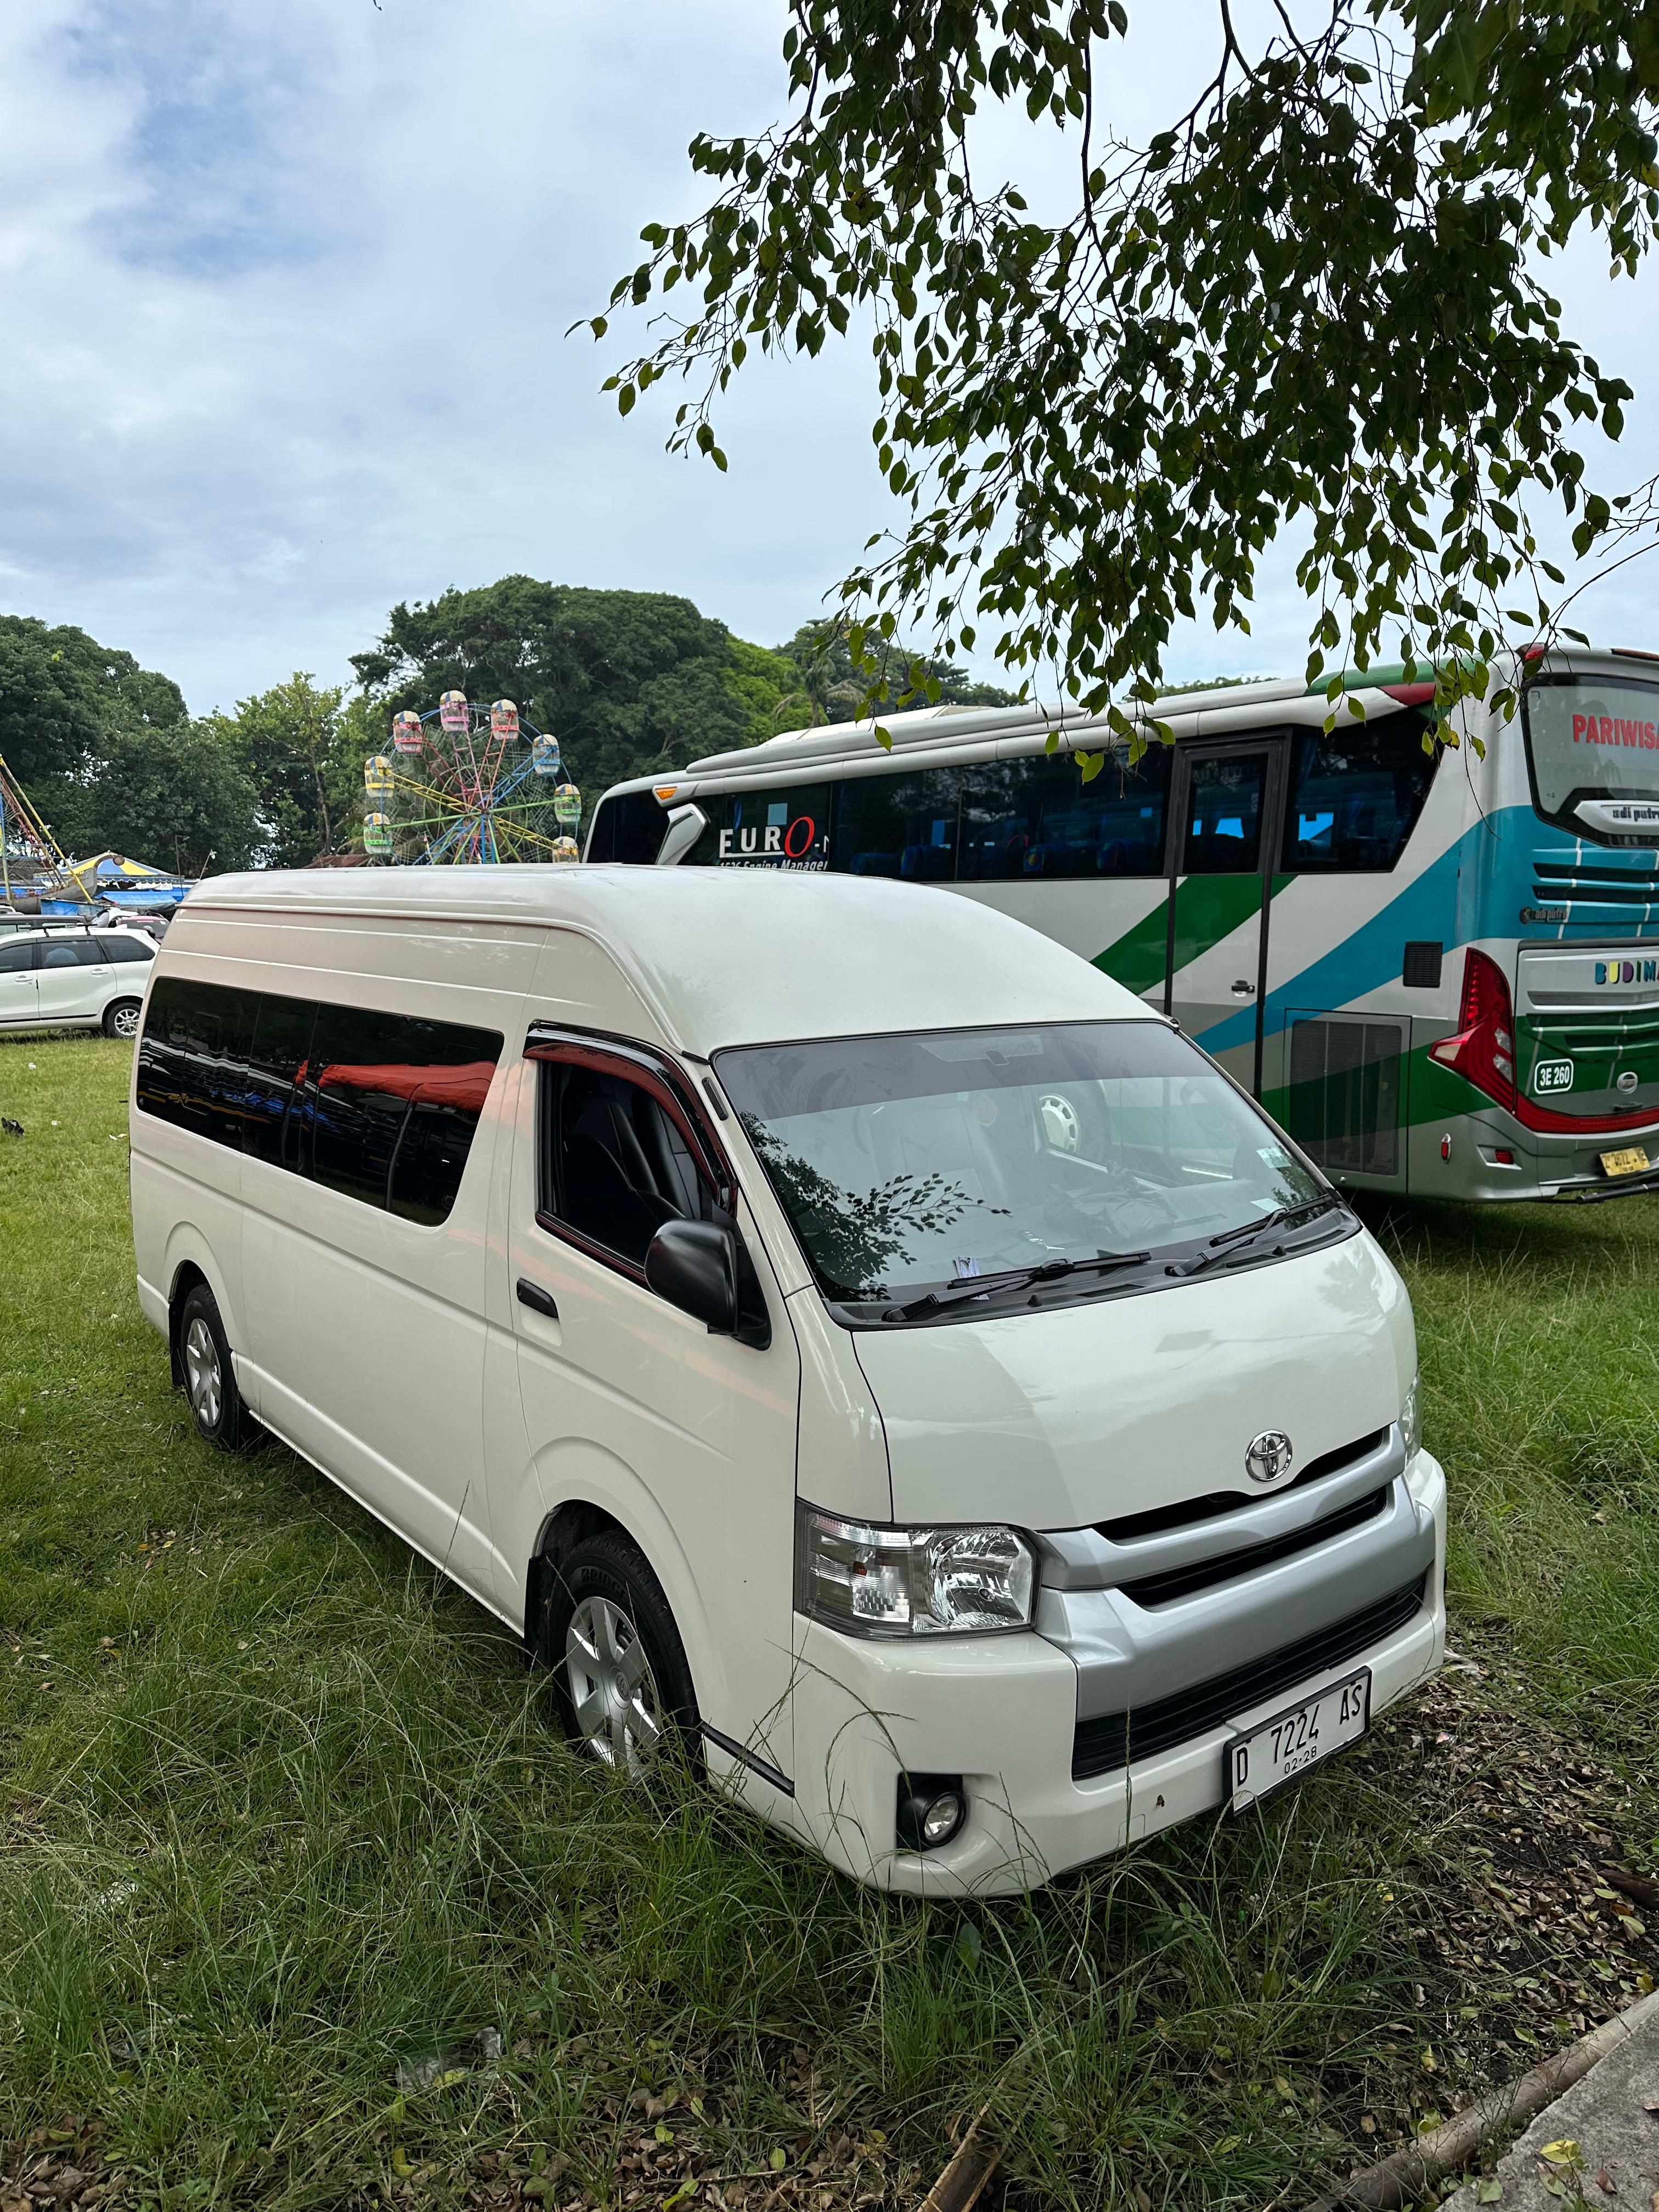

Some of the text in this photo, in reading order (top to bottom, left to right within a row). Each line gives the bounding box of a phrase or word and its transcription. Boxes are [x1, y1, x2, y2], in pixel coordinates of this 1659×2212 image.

[1634, 808, 1659, 822] putr
[1595, 960, 1659, 985] BUDIM
[1540, 1065, 1570, 1086] 3E 260
[1237, 1684, 1362, 1787] D 7224 AS
